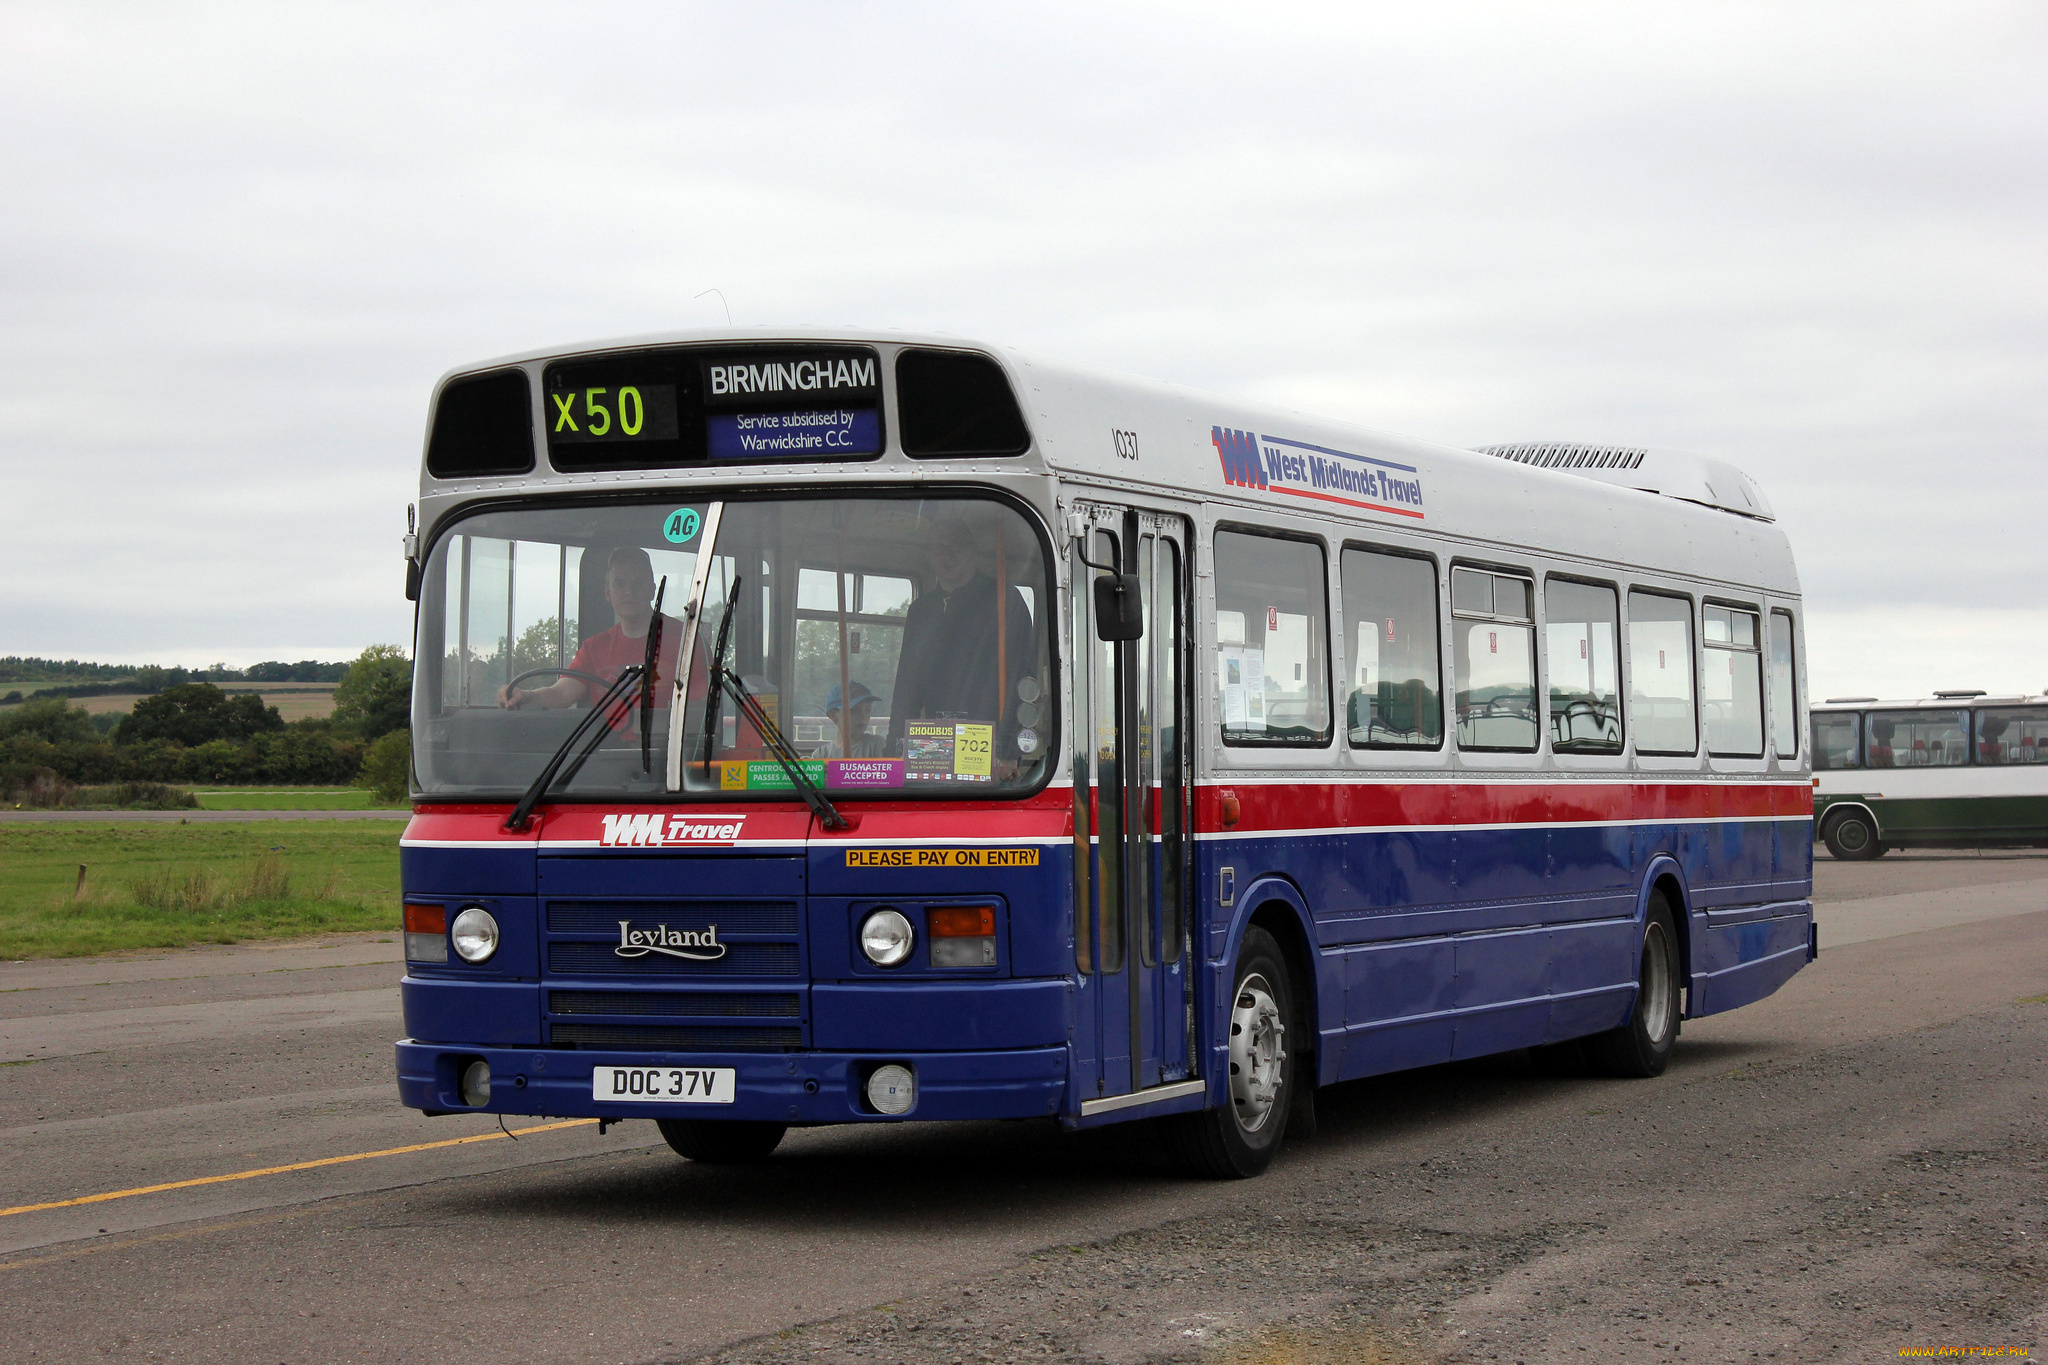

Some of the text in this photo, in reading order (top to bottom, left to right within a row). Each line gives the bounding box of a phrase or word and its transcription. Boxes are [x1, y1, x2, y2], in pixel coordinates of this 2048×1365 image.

[710, 358, 876, 395] BIRMINGHAM
[553, 385, 644, 436] X50
[736, 409, 854, 430] Service subsidised by
[740, 429, 853, 451] Warwickshire C.C.
[1111, 427, 1139, 461] 1037
[1263, 446, 1423, 506] West Midlands Travel
[668, 515, 697, 537] AG
[909, 726, 954, 736] SHOWBUS
[960, 739, 989, 753] 702
[753, 773, 780, 781] PASSES
[805, 764, 823, 772] AND
[839, 763, 893, 771] BUSMASTER
[843, 771, 888, 780] ACCEPTED
[600, 814, 744, 846] WM Travel
[848, 849, 1038, 866] PLEASE PAY ON ENTRY
[615, 920, 726, 959] Leyland
[612, 1070, 716, 1096] DOC 37V
